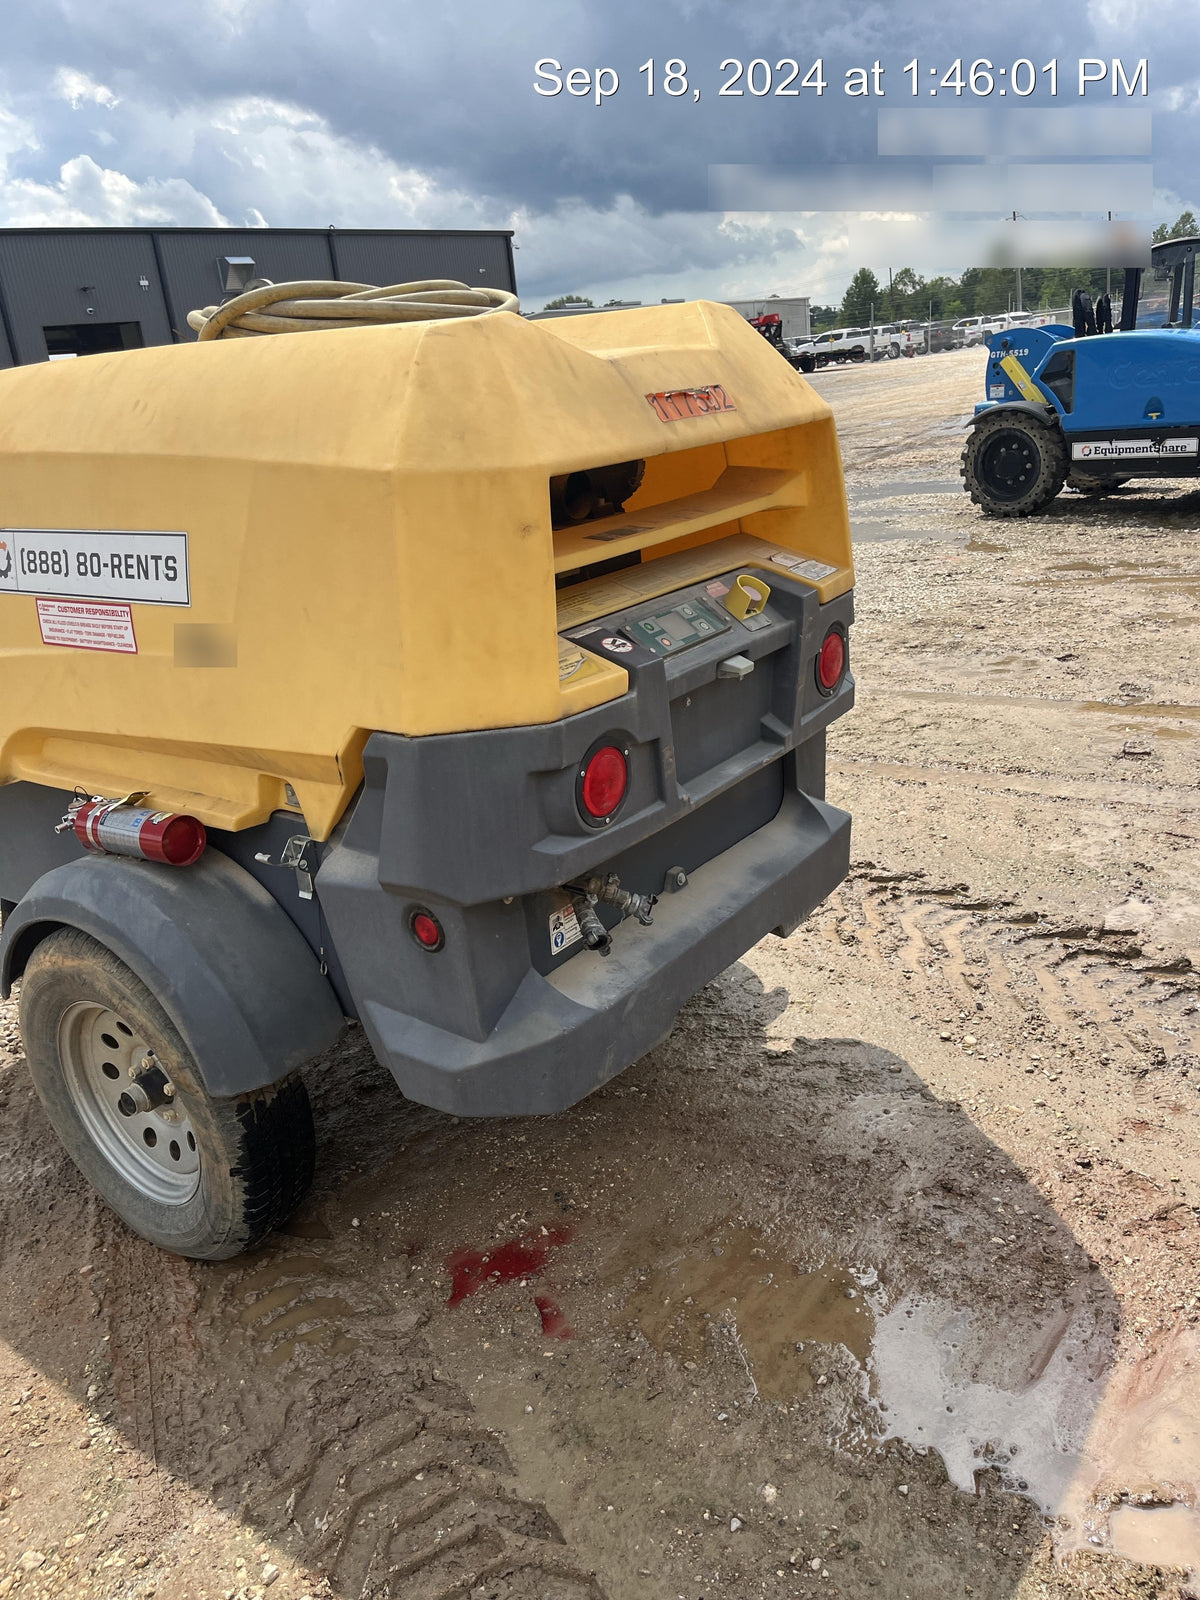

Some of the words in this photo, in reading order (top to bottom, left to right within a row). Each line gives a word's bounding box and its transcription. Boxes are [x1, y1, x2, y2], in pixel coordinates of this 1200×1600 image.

[1093, 444, 1187, 457] EquipmentShare
[20, 548, 69, 577] (888)
[76, 552, 178, 581] 80-RENTS
[57, 605, 85, 614] CUSTOMER
[85, 607, 129, 618] RESPONSIBILITY
